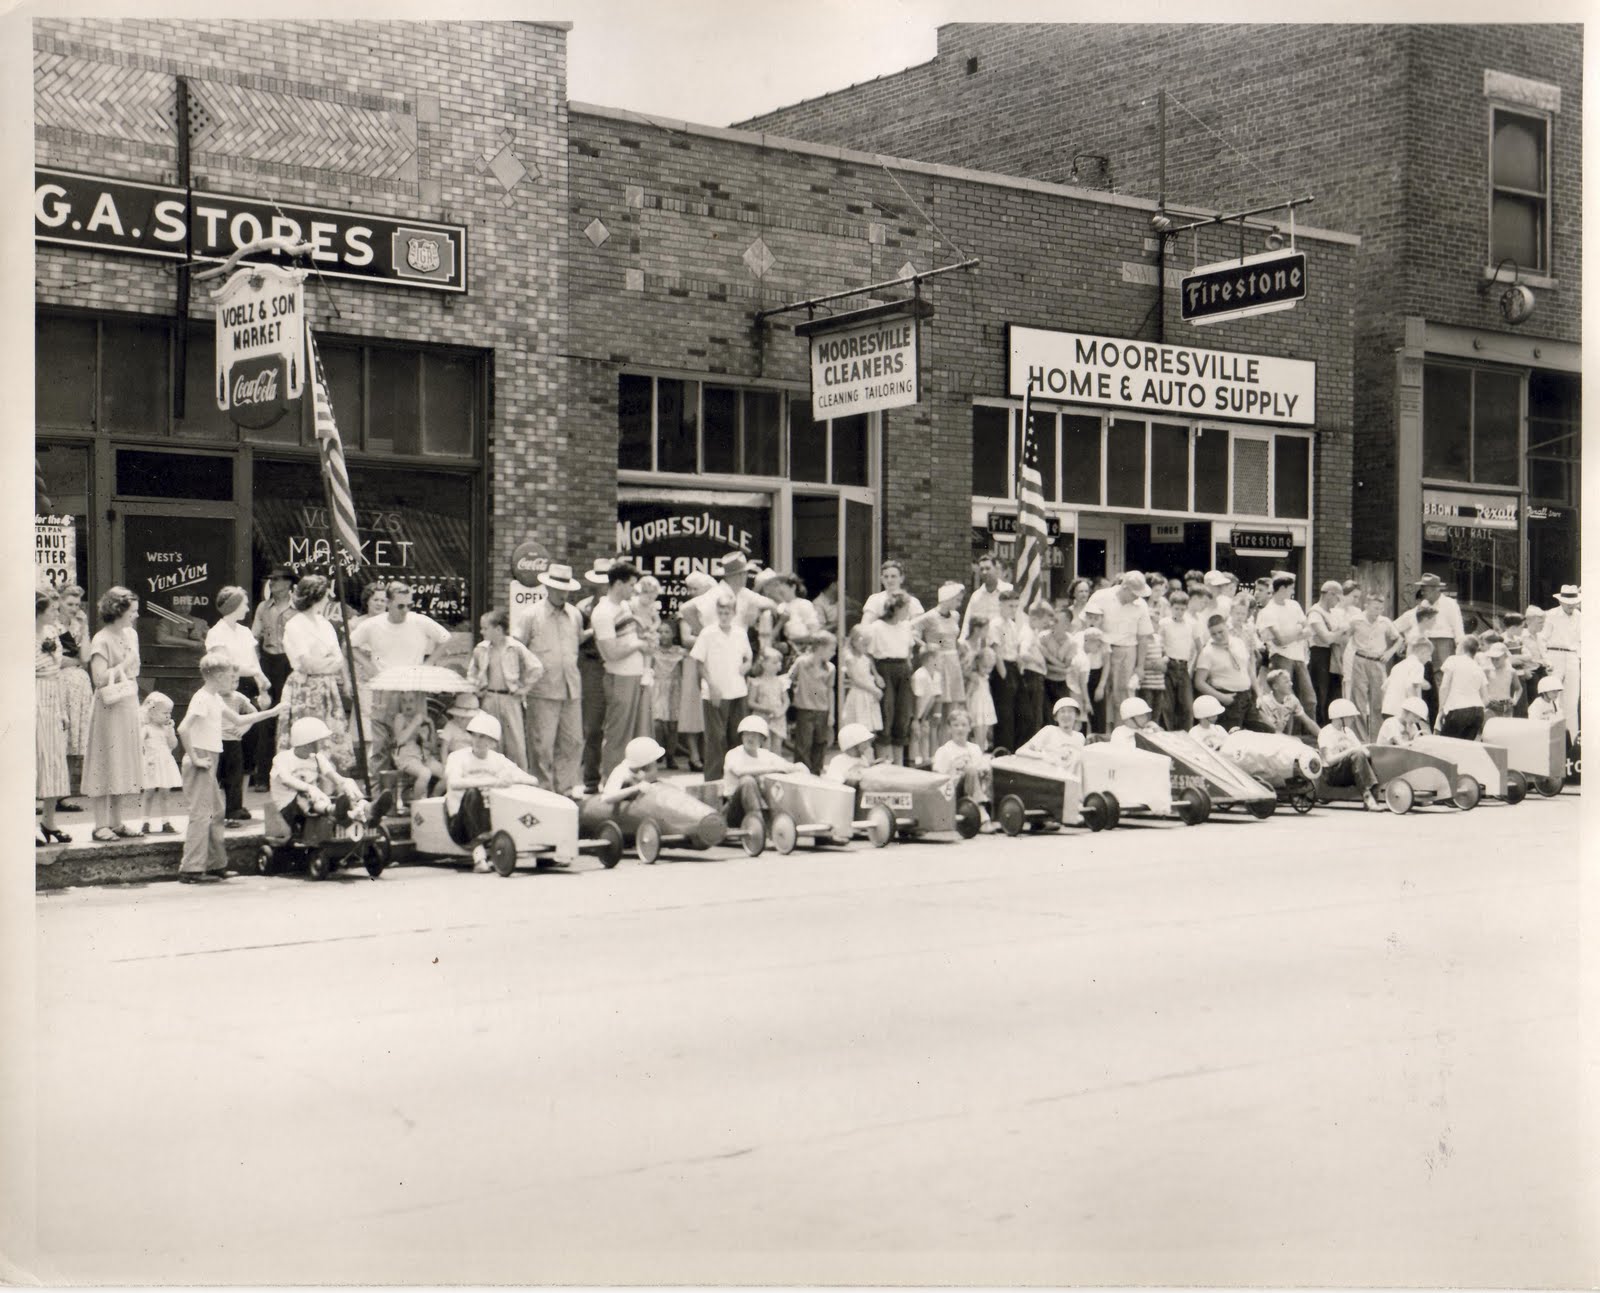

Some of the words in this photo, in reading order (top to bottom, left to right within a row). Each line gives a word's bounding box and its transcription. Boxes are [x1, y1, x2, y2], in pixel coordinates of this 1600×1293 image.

[153, 200, 374, 266] STORES
[1186, 266, 1301, 311] Firestone
[222, 302, 255, 328] VOELZ
[259, 300, 267, 320] &
[272, 293, 295, 318] SON
[233, 321, 281, 351] MARKET
[819, 327, 911, 364] MOORESVILLE
[824, 353, 904, 386] CLEANERS
[1076, 338, 1260, 384] MOORESVILLE
[818, 389, 859, 409] CLEANING
[864, 380, 913, 400] TAILORING
[1029, 365, 1112, 399] HOME
[1120, 375, 1133, 402] &
[1141, 379, 1206, 408] AUTO
[1215, 386, 1299, 418] SUPPLY
[1474, 503, 1517, 524] Rexall
[616, 512, 753, 554] MOORESVILLE
[1157, 526, 1179, 535] TIRES
[1232, 532, 1292, 548] Firestone
[1470, 528, 1493, 540] RATE
[146, 551, 183, 562] WEST'S
[289, 536, 414, 567] MAKET
[147, 574, 177, 593] YUM
[177, 563, 208, 583] YUM
[173, 595, 209, 606] BREAD
[515, 592, 543, 604] OPE
